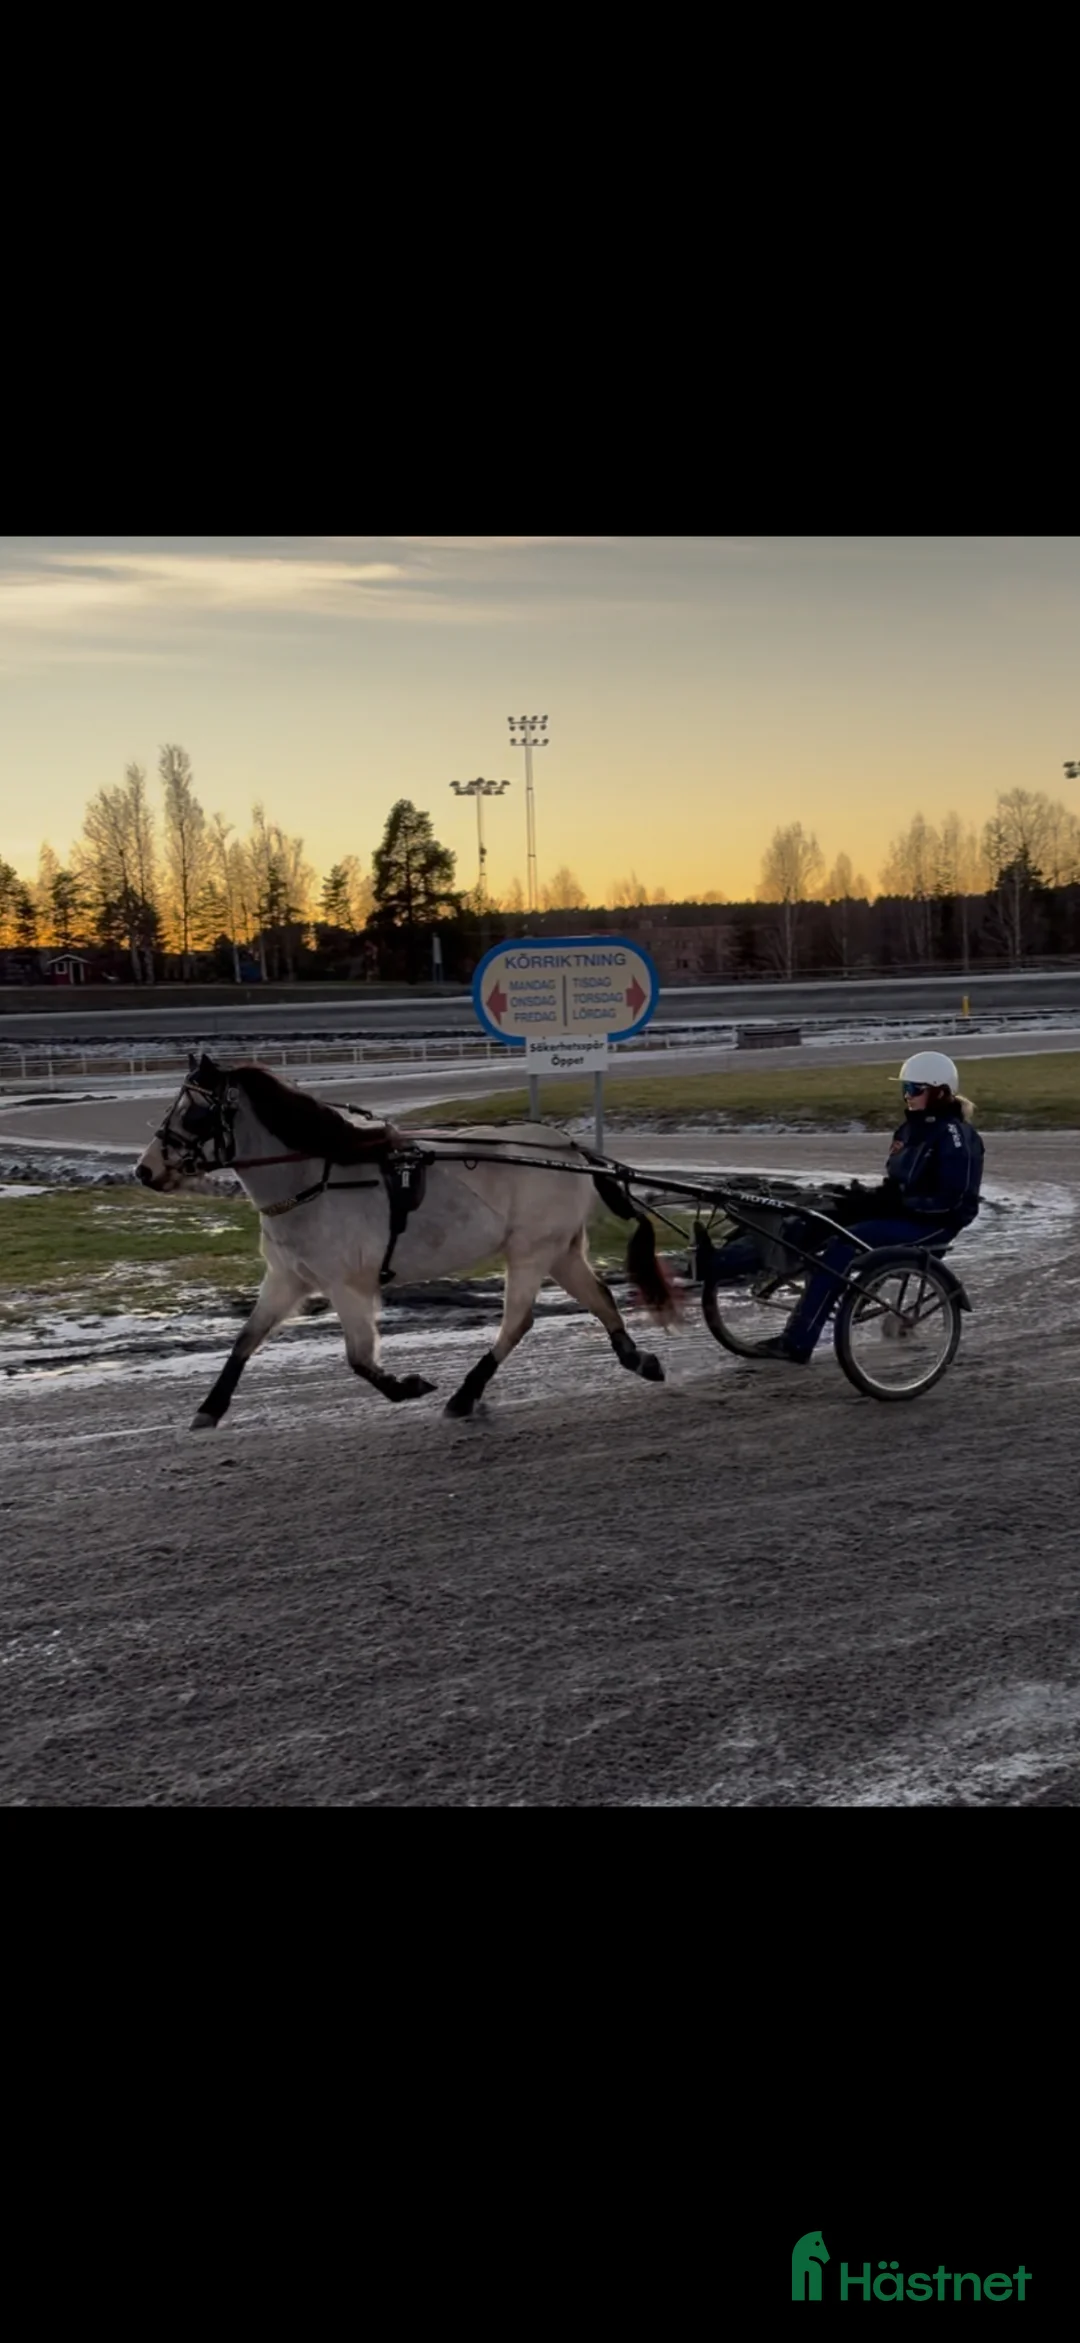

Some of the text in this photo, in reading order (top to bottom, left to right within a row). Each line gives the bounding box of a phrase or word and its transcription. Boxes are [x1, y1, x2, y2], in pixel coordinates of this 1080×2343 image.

[505, 953, 626, 969] KÖRRIKTNING
[572, 976, 612, 988] TISDAG
[510, 995, 556, 1007] ONSDAG
[573, 992, 623, 1004] TORSDAG
[514, 1011, 557, 1022] FREDAG
[572, 1007, 616, 1019] LÖRDAG
[551, 1054, 584, 1067] Öppet
